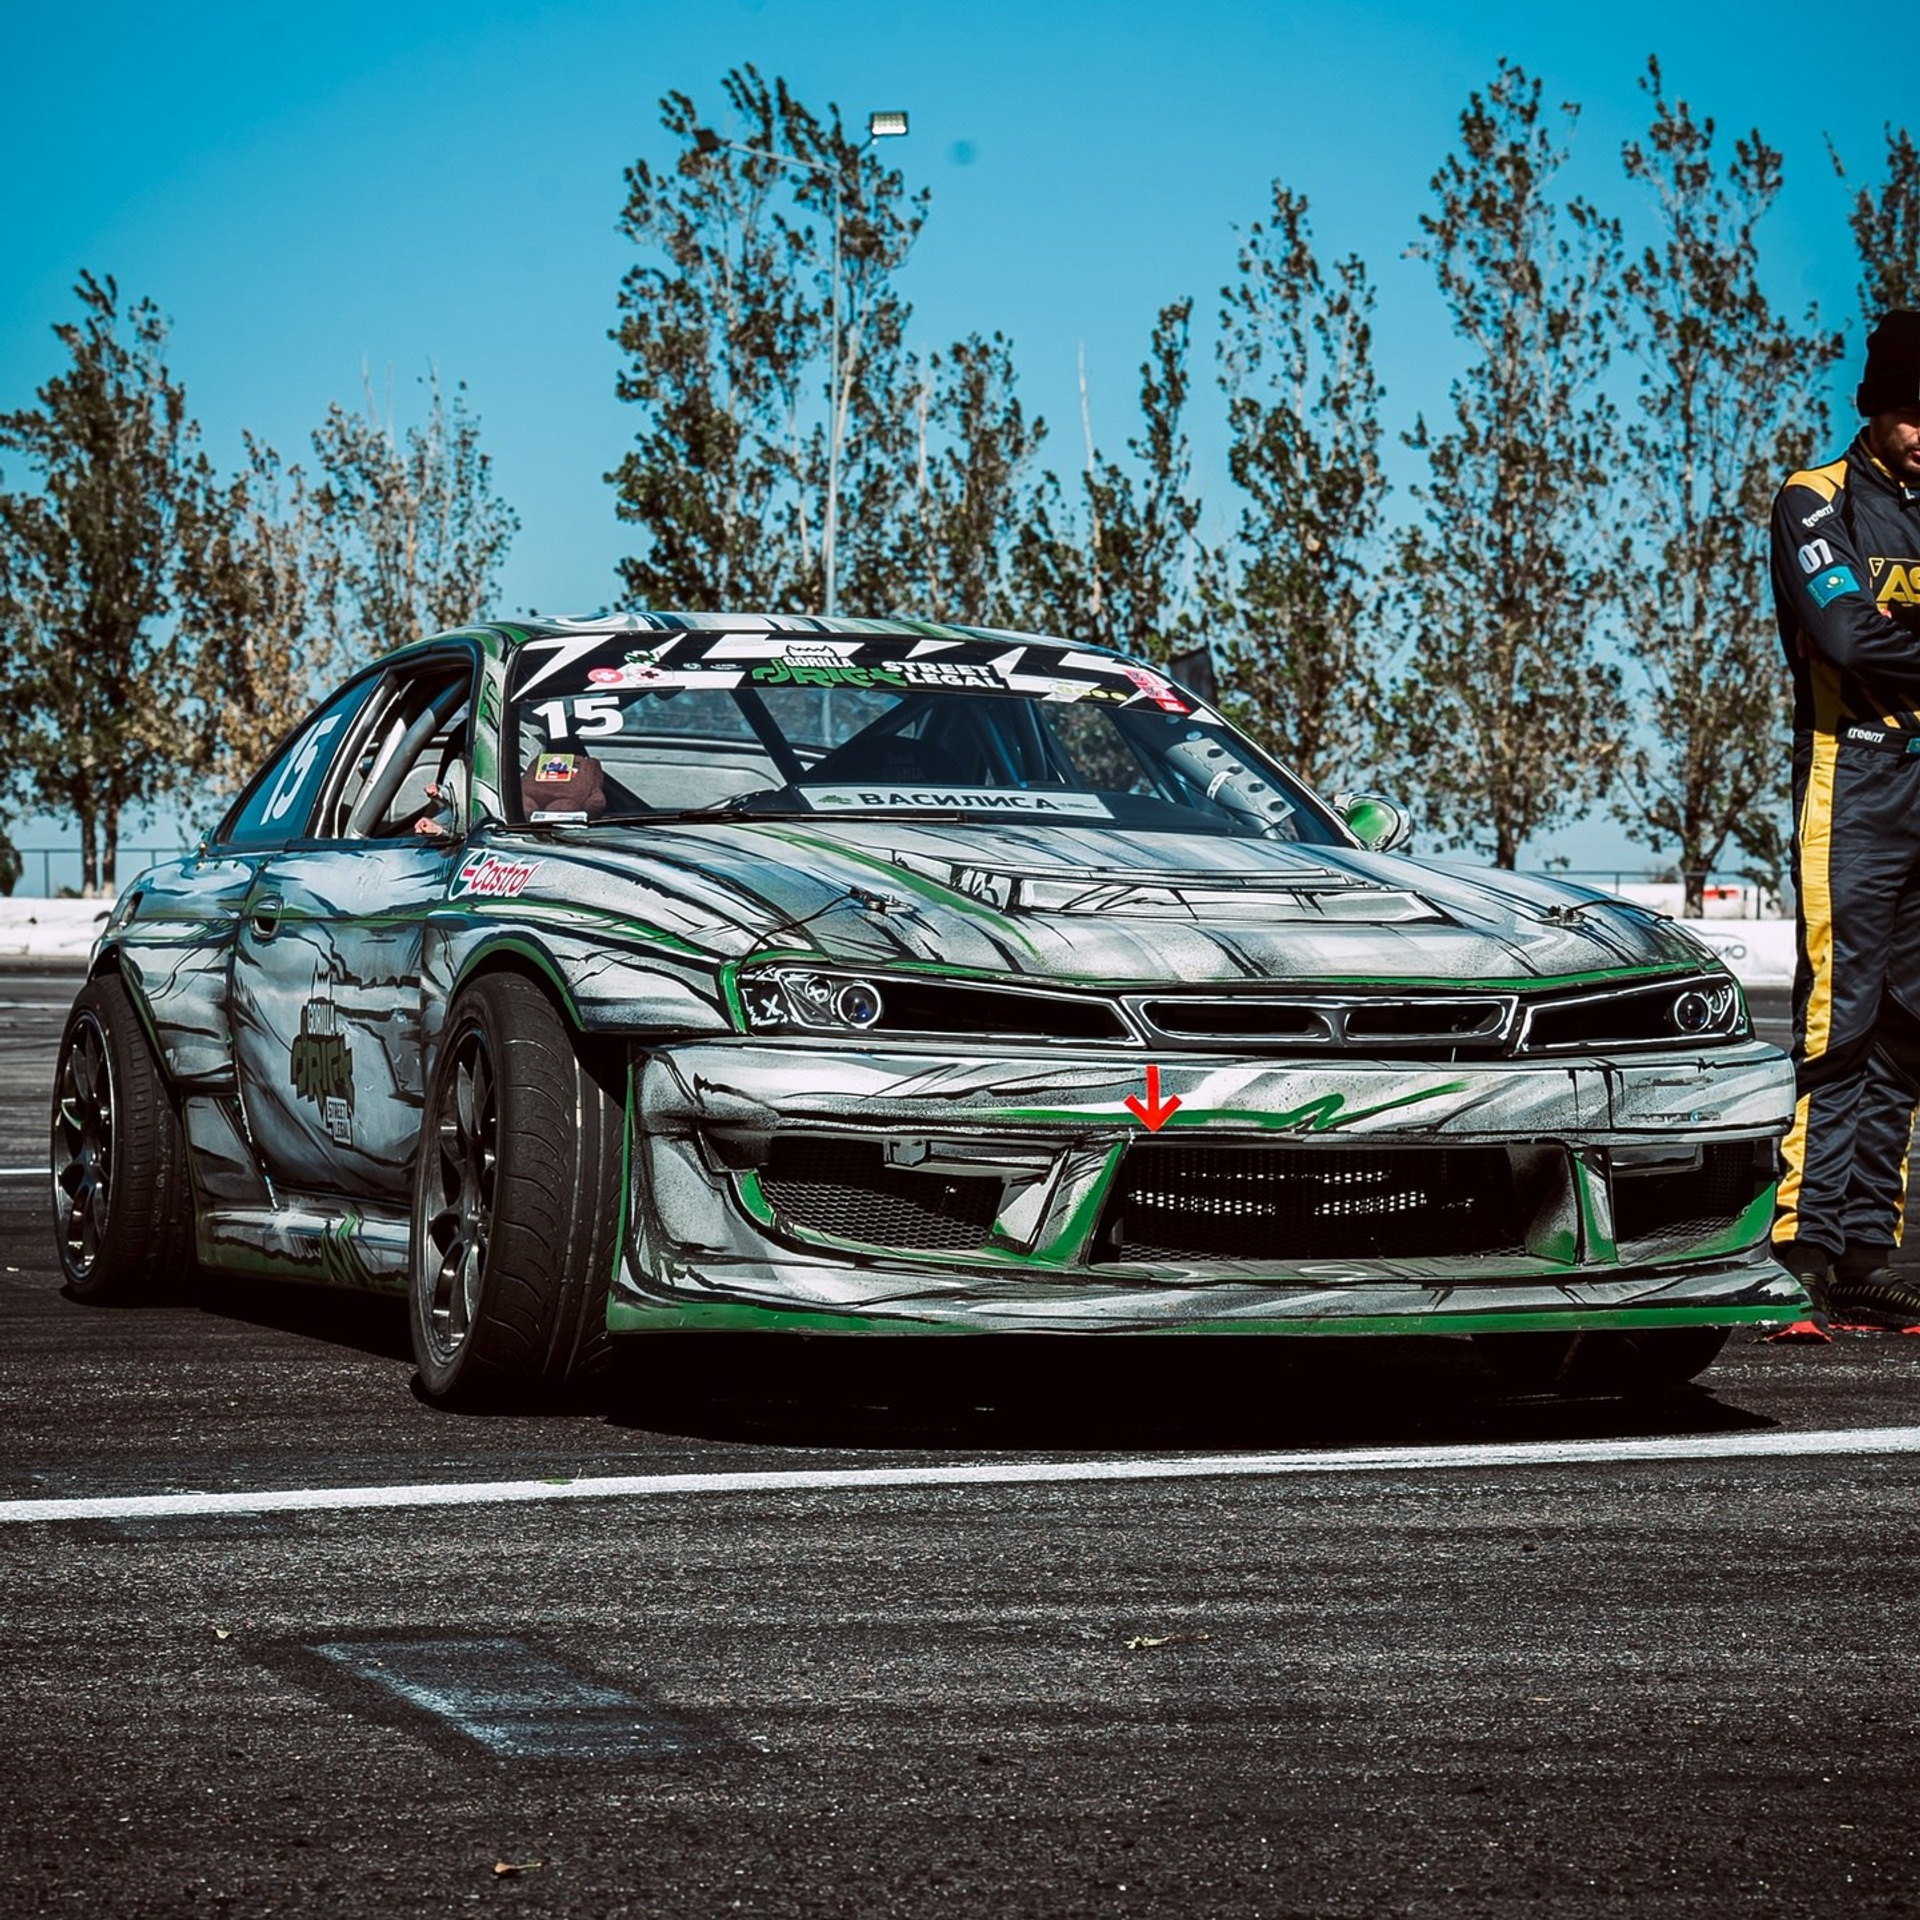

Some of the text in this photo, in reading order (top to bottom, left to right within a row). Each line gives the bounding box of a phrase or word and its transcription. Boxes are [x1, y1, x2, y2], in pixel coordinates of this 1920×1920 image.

[783, 656, 857, 668] GORILLA
[881, 660, 990, 677] STREET
[904, 672, 1006, 690] LEGAL
[531, 696, 624, 740] 15
[260, 713, 343, 826] 15
[857, 793, 1061, 811] ВАСИЛИСА
[470, 858, 543, 895] Castrol
